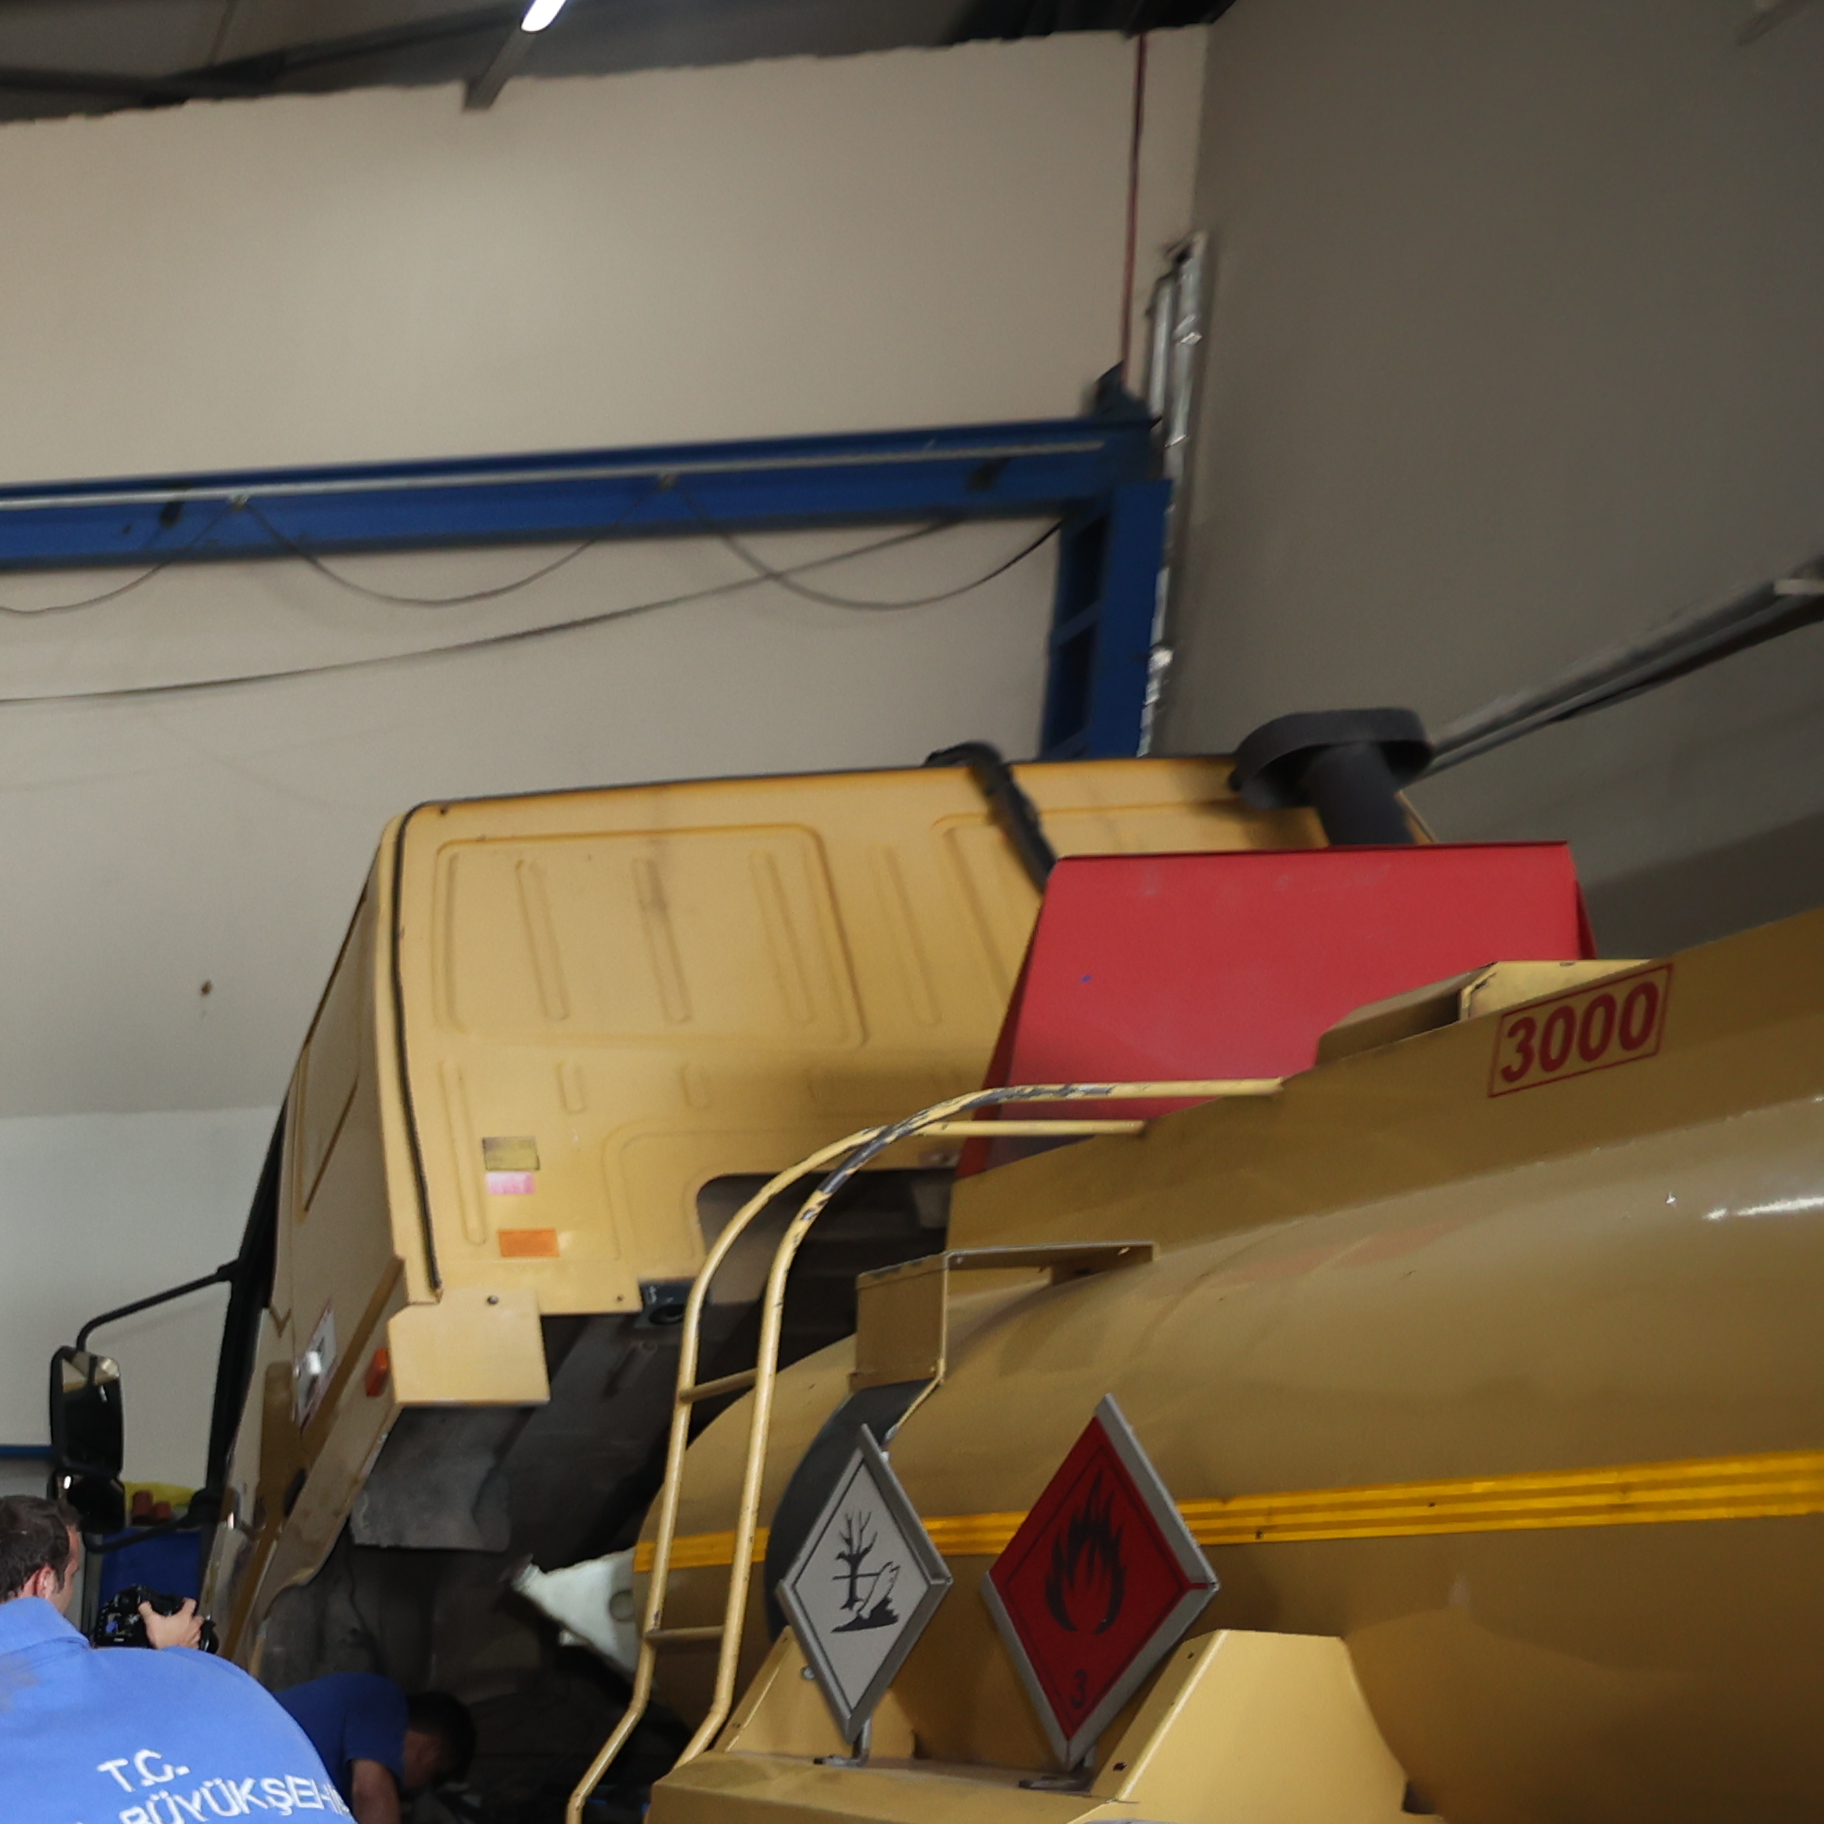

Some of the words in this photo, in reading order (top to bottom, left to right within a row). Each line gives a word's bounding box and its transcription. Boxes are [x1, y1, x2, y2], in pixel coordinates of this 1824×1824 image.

[1500, 981, 1660, 1083] 3000
[1070, 1669, 1088, 1710] 3
[96, 1748, 191, 1793] T.C.
